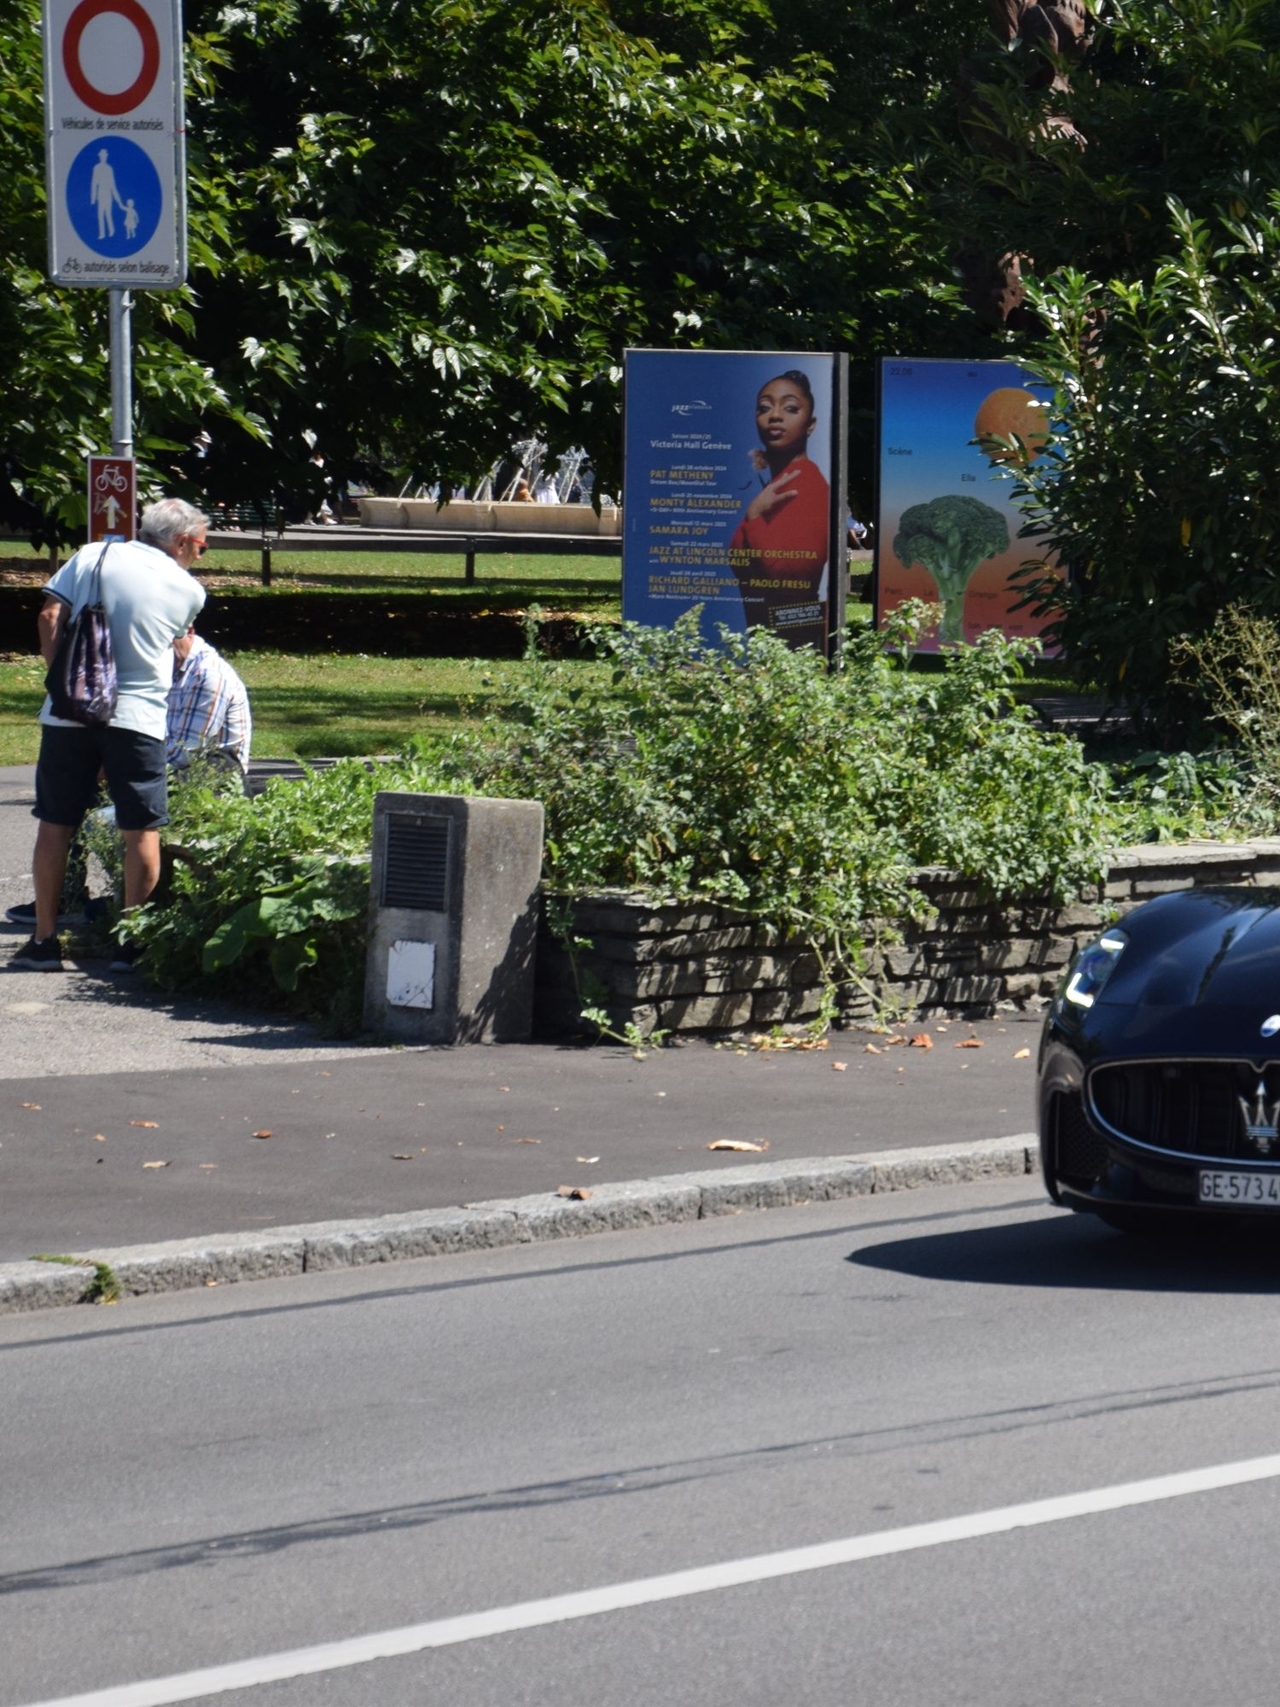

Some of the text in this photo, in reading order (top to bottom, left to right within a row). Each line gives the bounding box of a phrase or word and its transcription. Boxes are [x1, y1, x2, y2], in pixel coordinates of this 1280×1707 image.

[62, 117, 164, 130] Véhicules de service autorisés
[84, 260, 116, 272] autorisés
[118, 260, 137, 272] selon
[650, 440, 682, 448] Victoria
[702, 441, 732, 450] Genève
[650, 470, 714, 479] PAT METHENY
[961, 473, 976, 482] Ella
[650, 498, 742, 508] MONTY ALEXANDER
[650, 525, 709, 535] SAMARA JOY
[649, 546, 670, 554] JAZZ
[686, 548, 725, 556] LINCOLN
[727, 548, 762, 558] CENTER
[764, 550, 817, 559] ORCHESTRA
[659, 556, 702, 564] WYNTON
[704, 557, 750, 566] MARSALIS
[649, 576, 690, 584] RICHARD
[692, 577, 739, 586] GALLIANO
[750, 579, 780, 588] PAOLO
[782, 580, 811, 589] FRESU
[649, 584, 719, 594] JAN LUNDGREN
